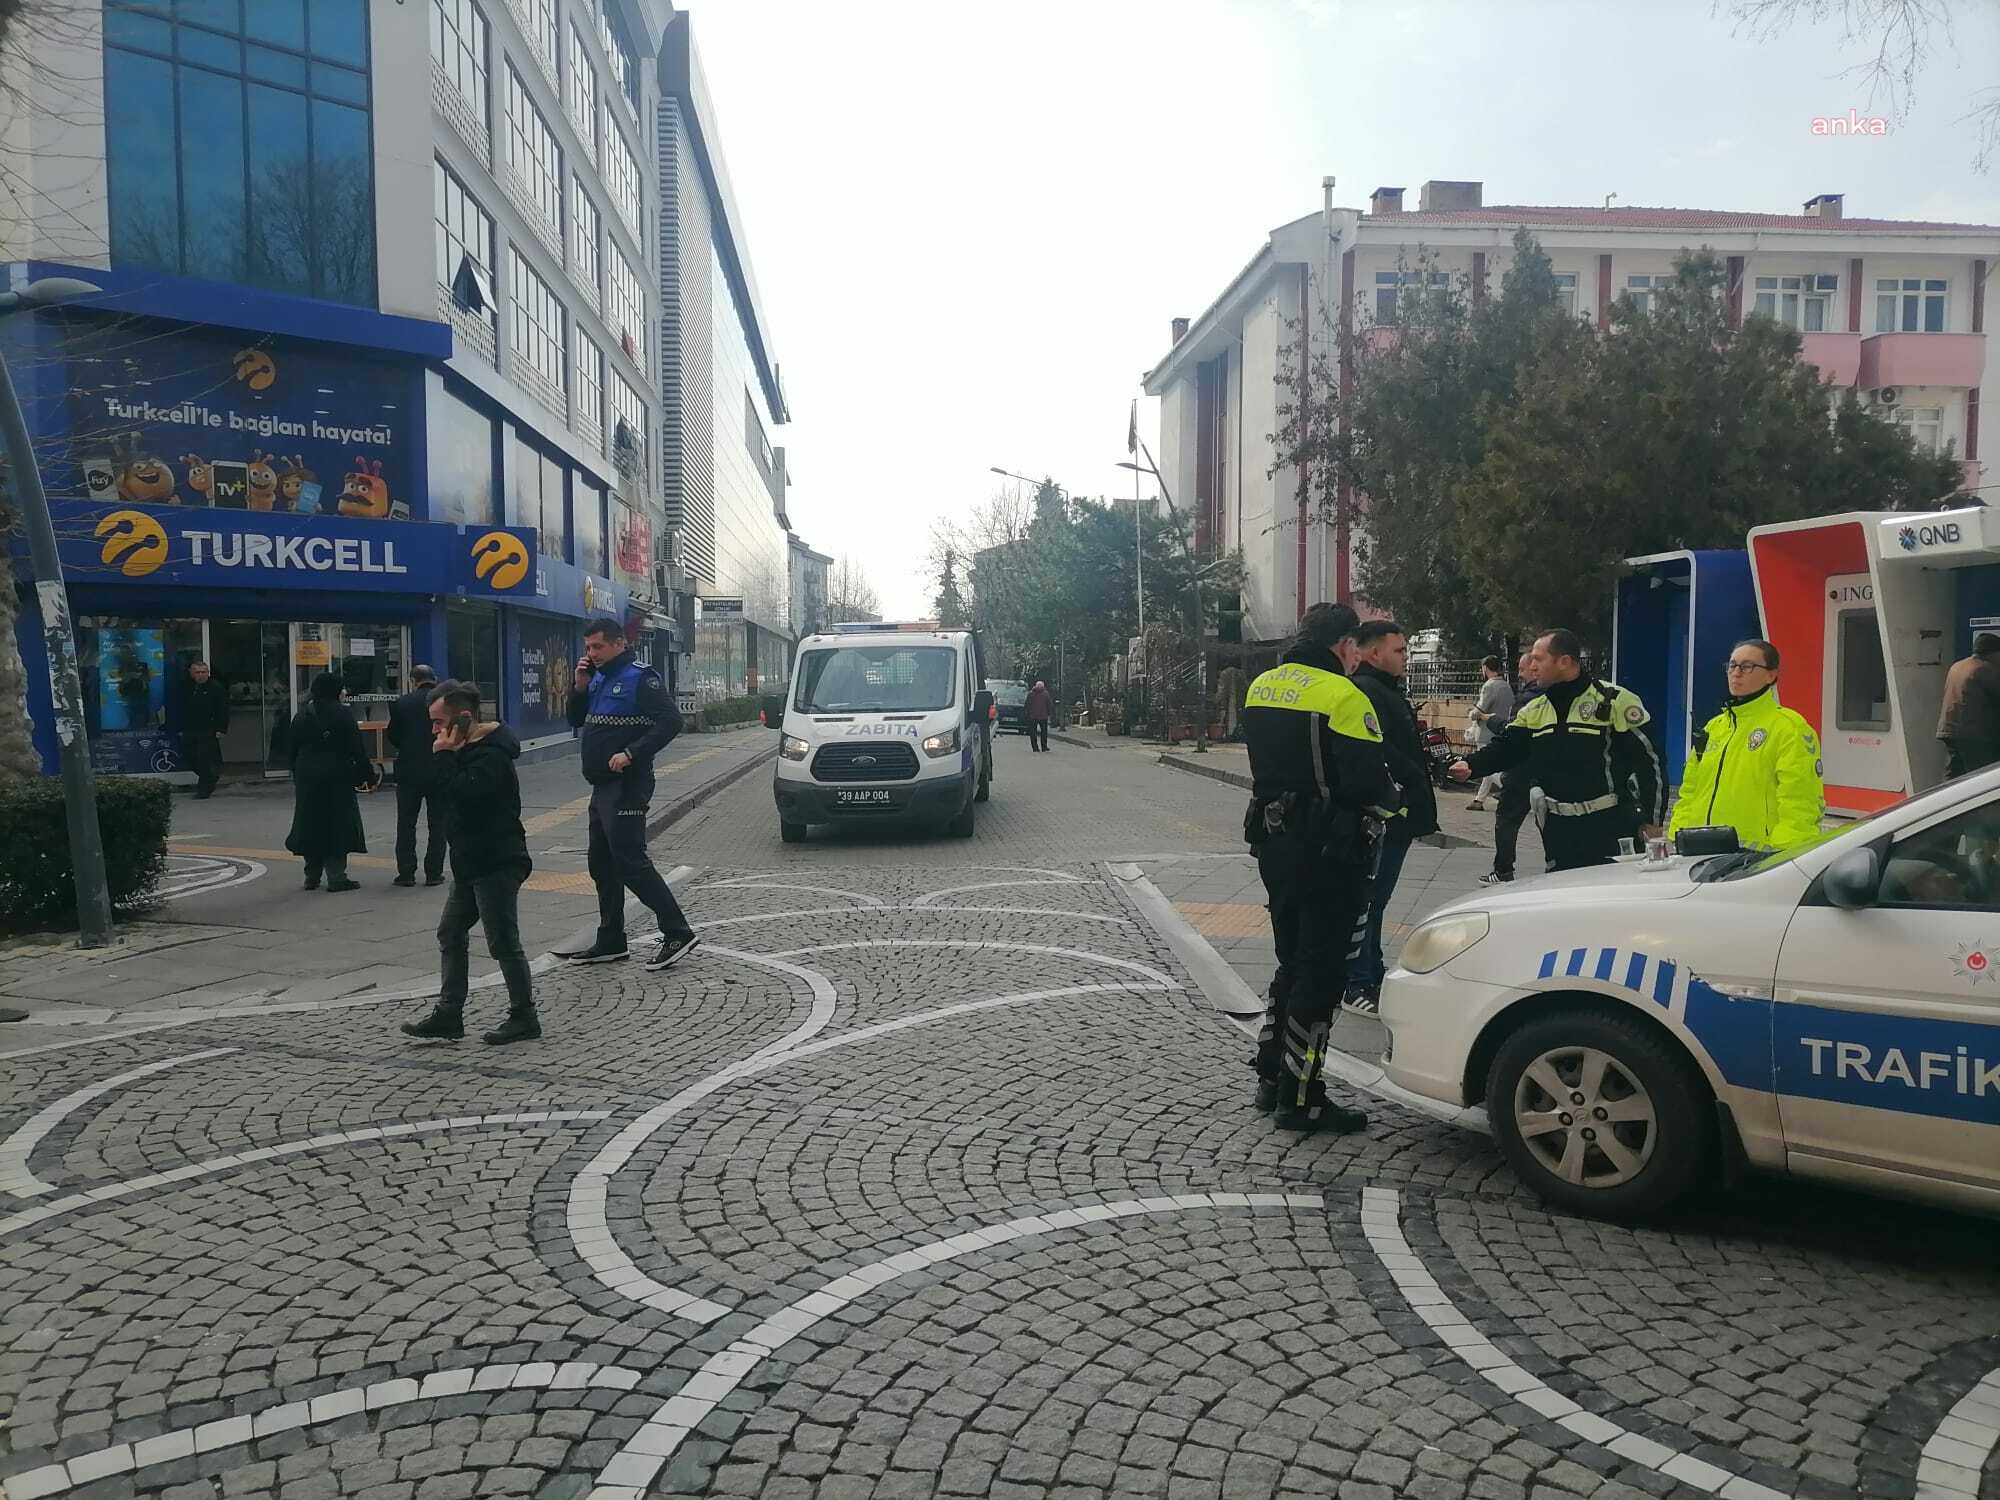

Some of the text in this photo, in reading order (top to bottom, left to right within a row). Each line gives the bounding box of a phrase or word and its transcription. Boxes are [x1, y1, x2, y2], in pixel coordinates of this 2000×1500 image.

[104, 397, 392, 445] Turkcell'le bağlan hayata!
[1919, 523, 1960, 546] QNB
[181, 530, 408, 574] TURKCELL
[1843, 585, 1873, 601] ING
[846, 723, 918, 737] ZABITA
[854, 791, 871, 801] AAP
[873, 790, 889, 800] 004
[1800, 1037, 2000, 1097] TRAFİK
